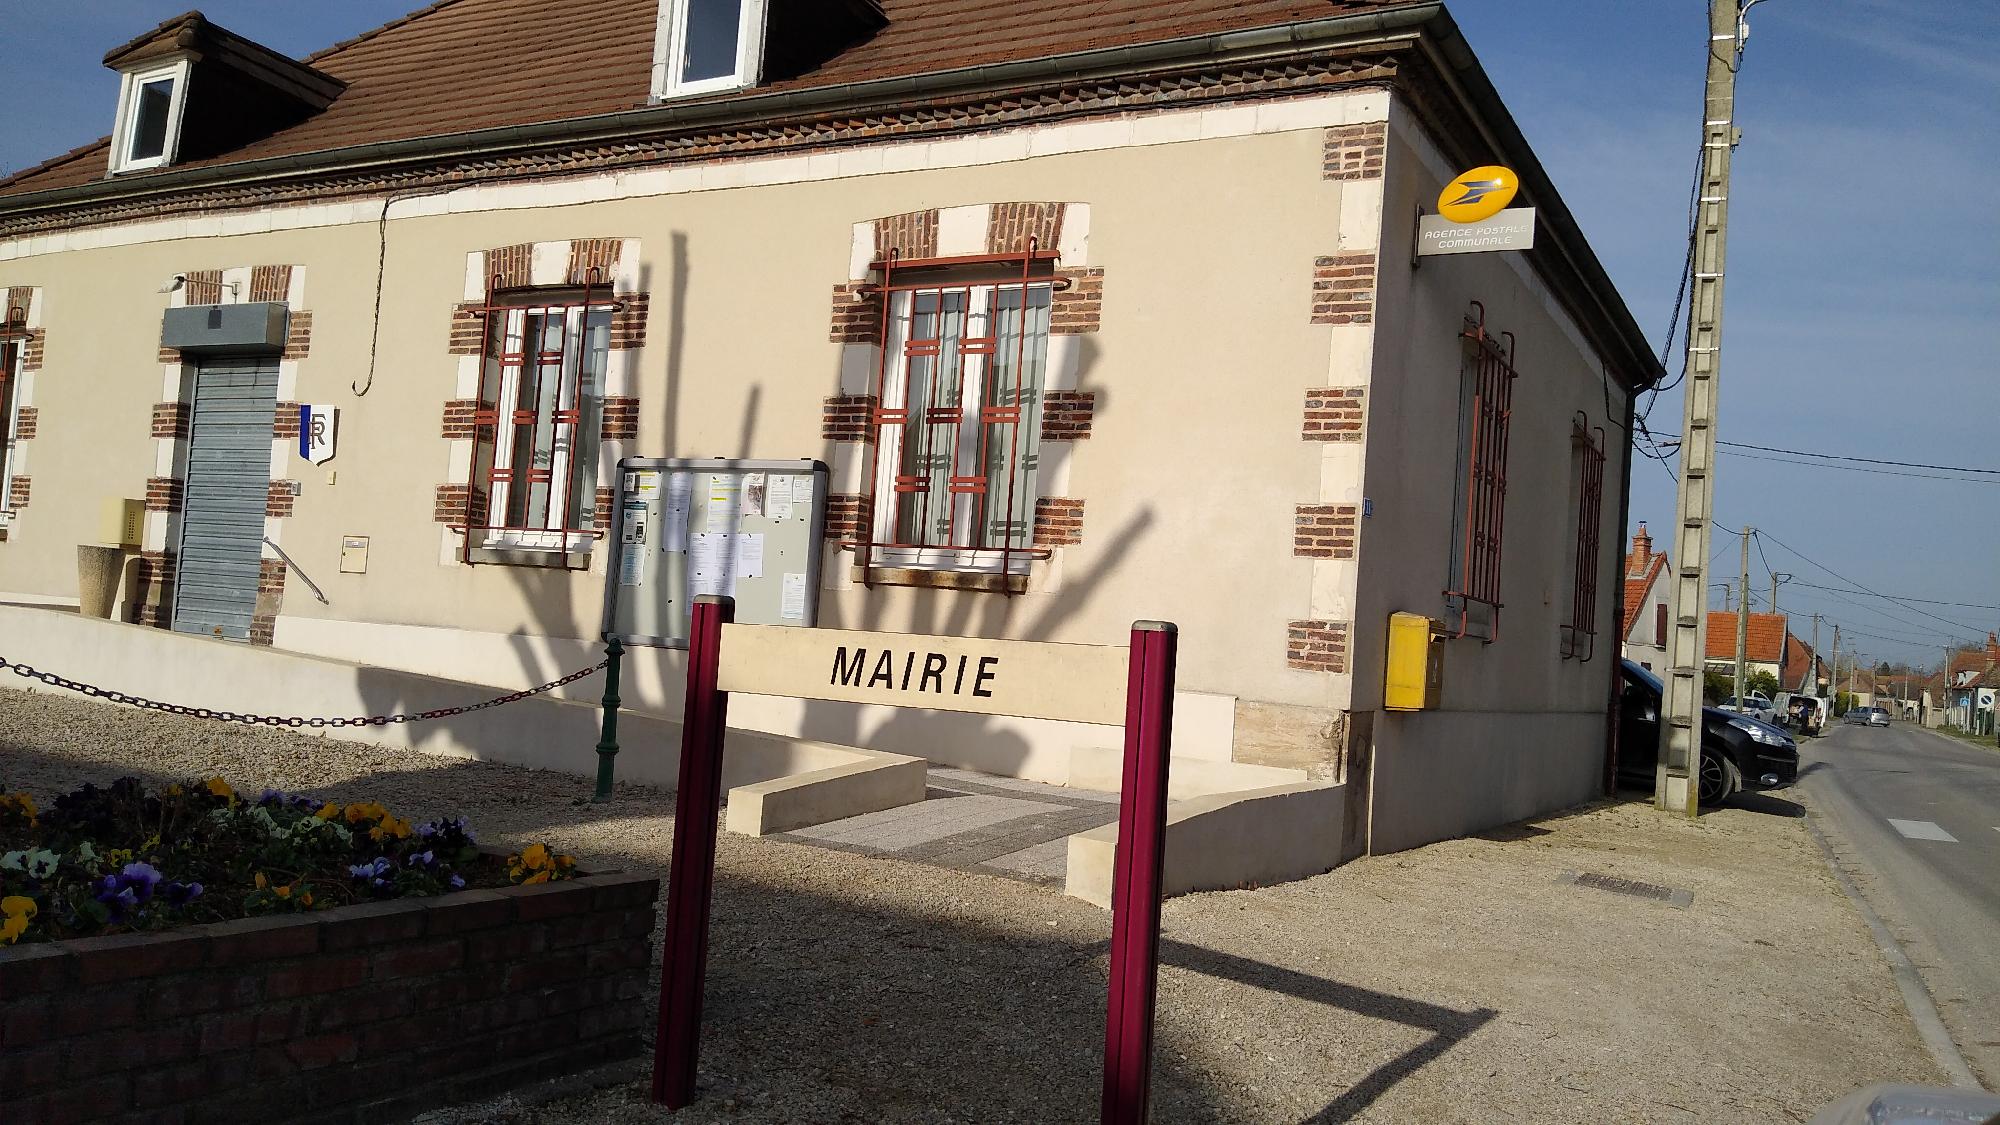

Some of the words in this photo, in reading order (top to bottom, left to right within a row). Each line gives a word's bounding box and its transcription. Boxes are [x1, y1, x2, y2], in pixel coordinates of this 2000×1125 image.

[1424, 228, 1473, 240] AGENCE
[1476, 224, 1529, 236] POSTALE
[1438, 235, 1513, 249] COMMUNALE
[830, 646, 999, 698] MAIRIE
